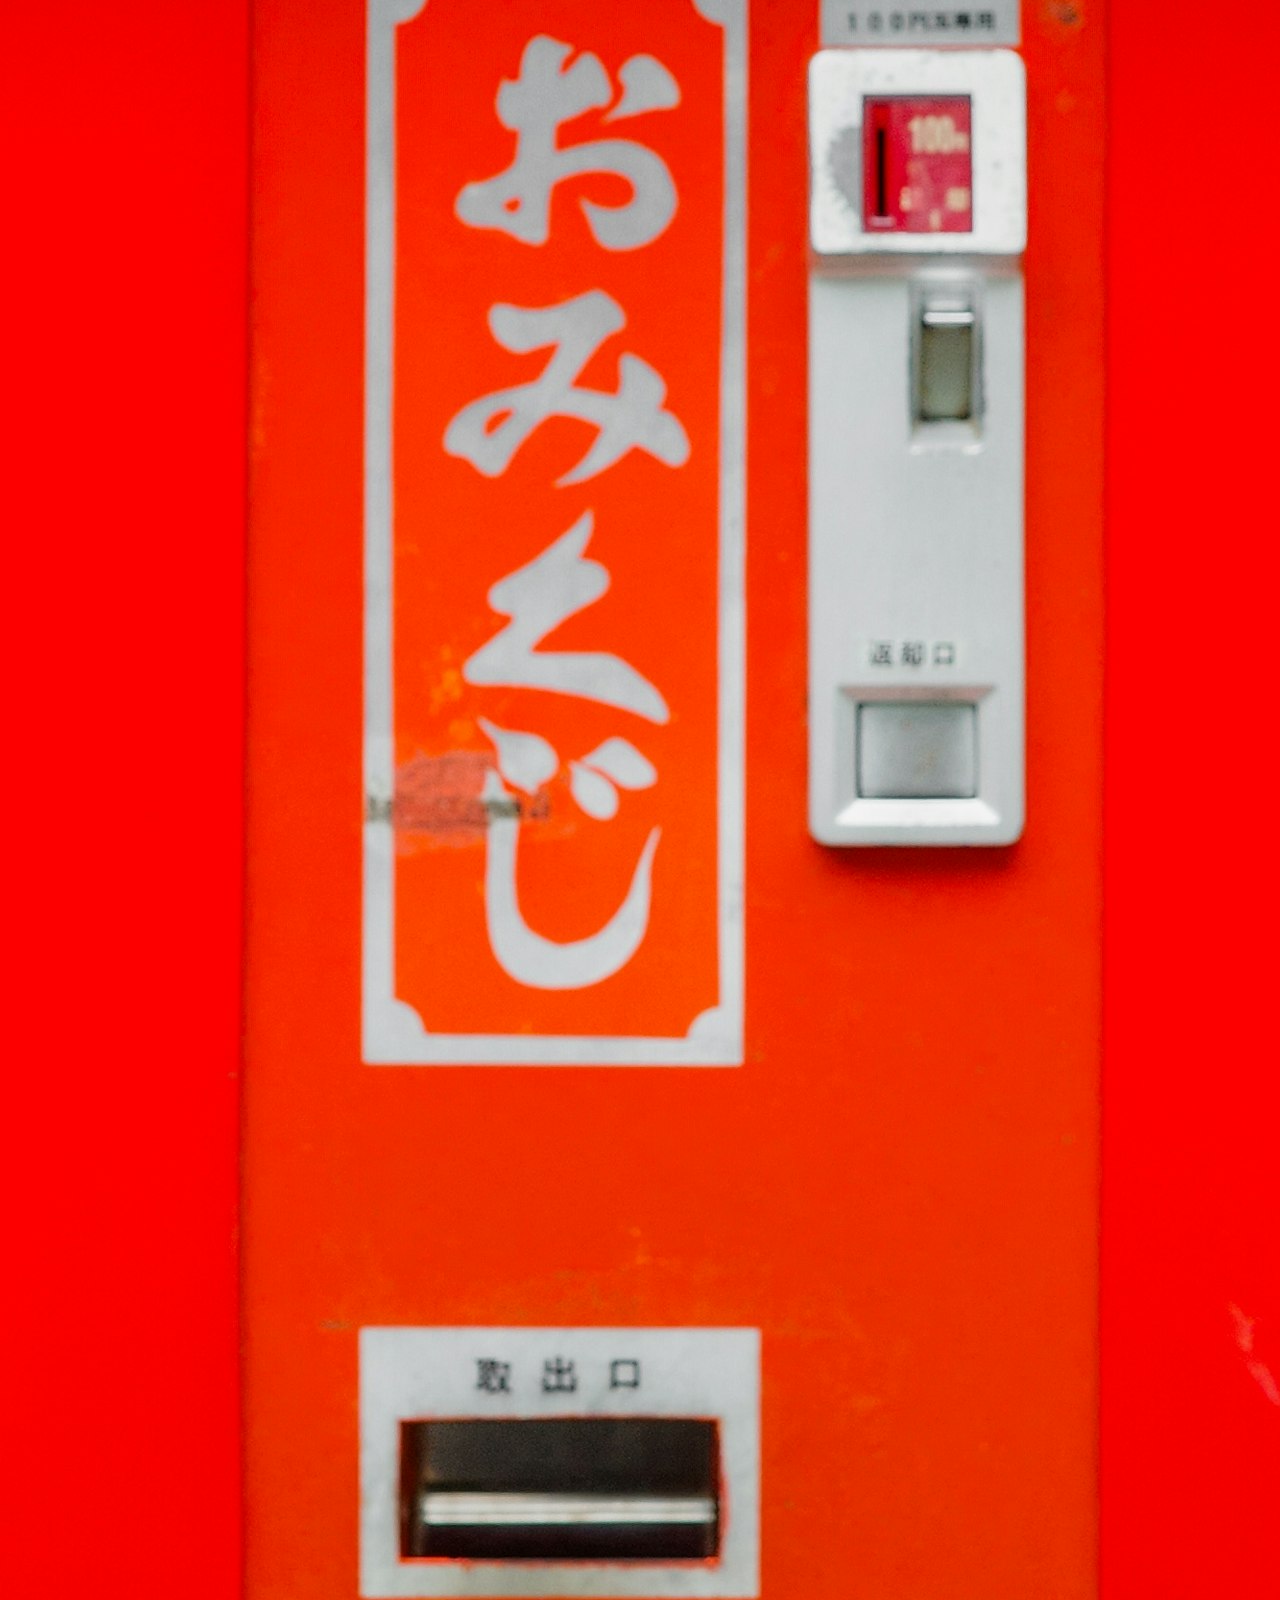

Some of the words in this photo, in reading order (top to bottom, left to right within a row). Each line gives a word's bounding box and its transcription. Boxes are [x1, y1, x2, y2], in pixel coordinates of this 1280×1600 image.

[443, 34, 692, 990] おみくじ
[869, 641, 956, 667] 返却口
[475, 1357, 642, 1395] 取出口
